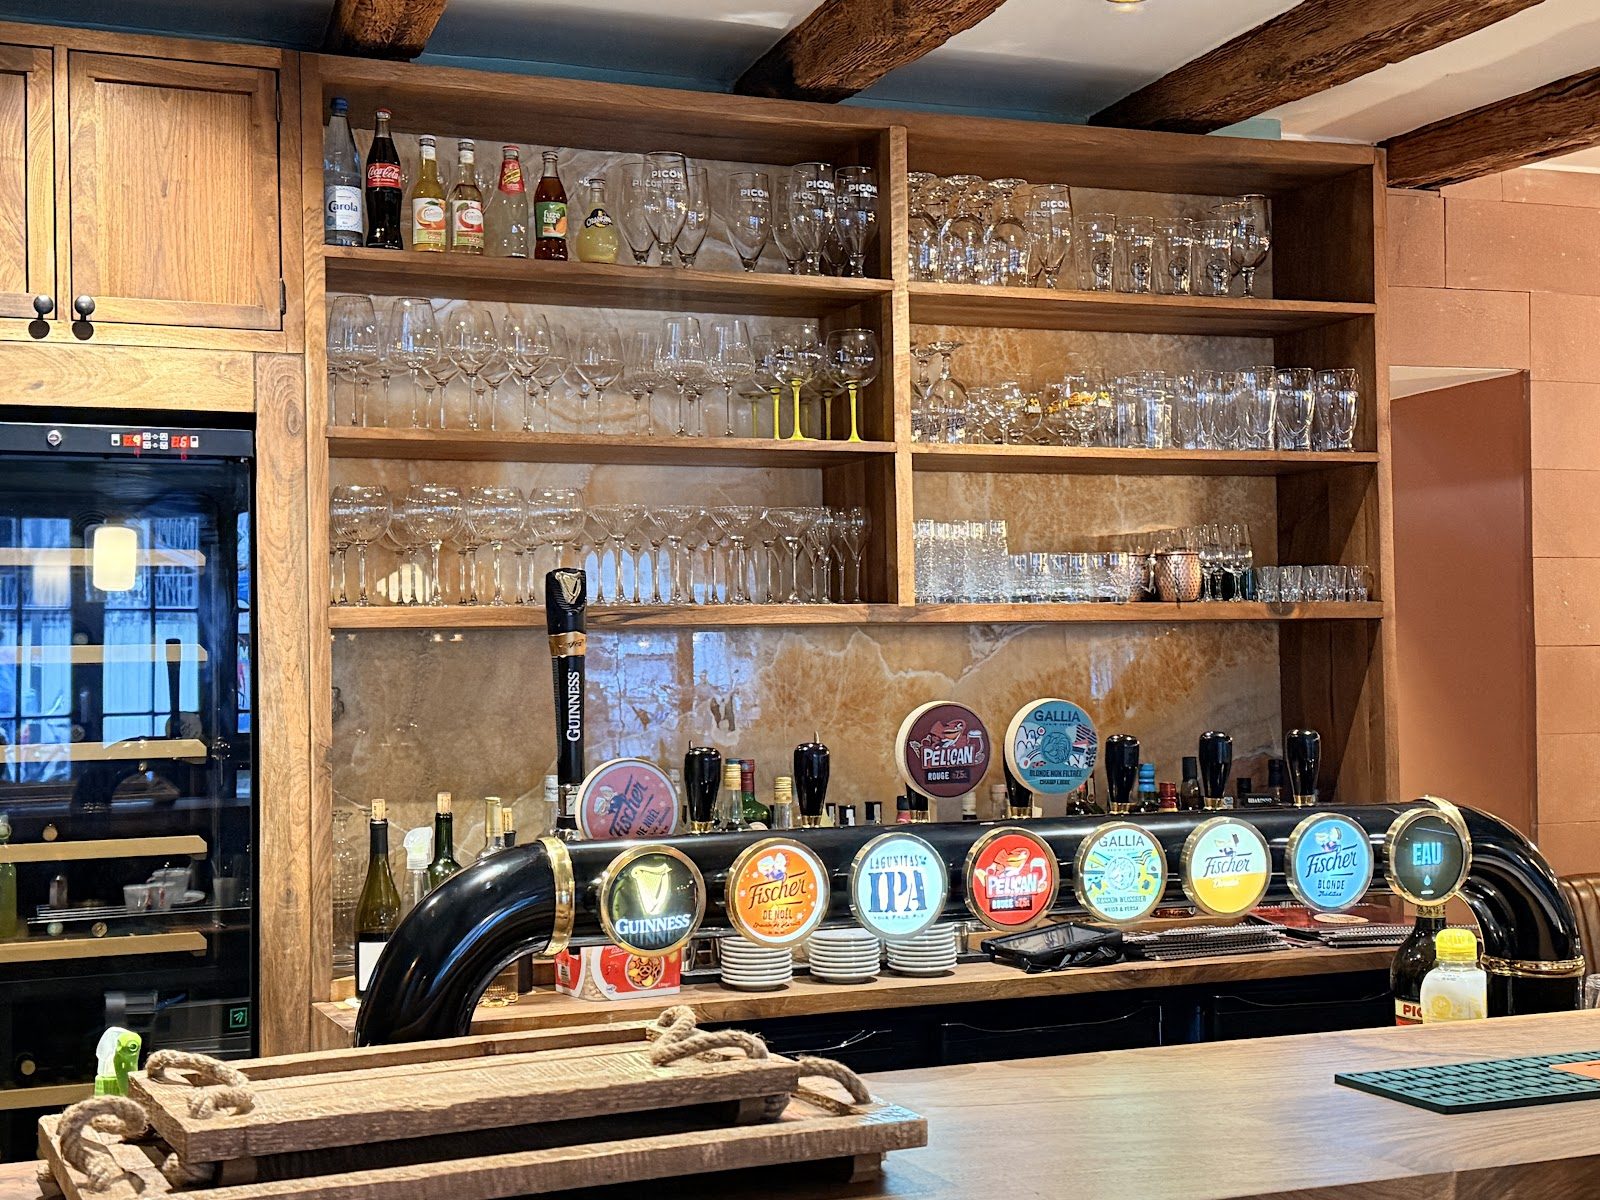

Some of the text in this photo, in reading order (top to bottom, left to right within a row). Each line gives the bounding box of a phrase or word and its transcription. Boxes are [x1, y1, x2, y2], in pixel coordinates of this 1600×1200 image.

[367, 166, 400, 179] Coca-Cola
[651, 170, 684, 179] PICON
[806, 181, 835, 190] PICON
[848, 184, 878, 193] PICON
[740, 189, 769, 198] PICON
[328, 200, 358, 213] Carola
[1040, 200, 1070, 209] PICON
[566, 671, 580, 742] GUINNESS
[1034, 710, 1080, 722] GALLIA
[927, 771, 950, 780] ROUGE
[1099, 835, 1145, 848] GALLIA
[1412, 842, 1442, 866] EAU
[870, 855, 919, 869] LAGUNITAS
[1203, 853, 1251, 878] Fischer
[1306, 844, 1358, 878] Fischer
[749, 871, 807, 909] Fischer
[868, 870, 928, 912] IPA
[1318, 880, 1345, 889] BLONDE
[763, 909, 773, 920] DE
[615, 913, 691, 935] GUINNESS
